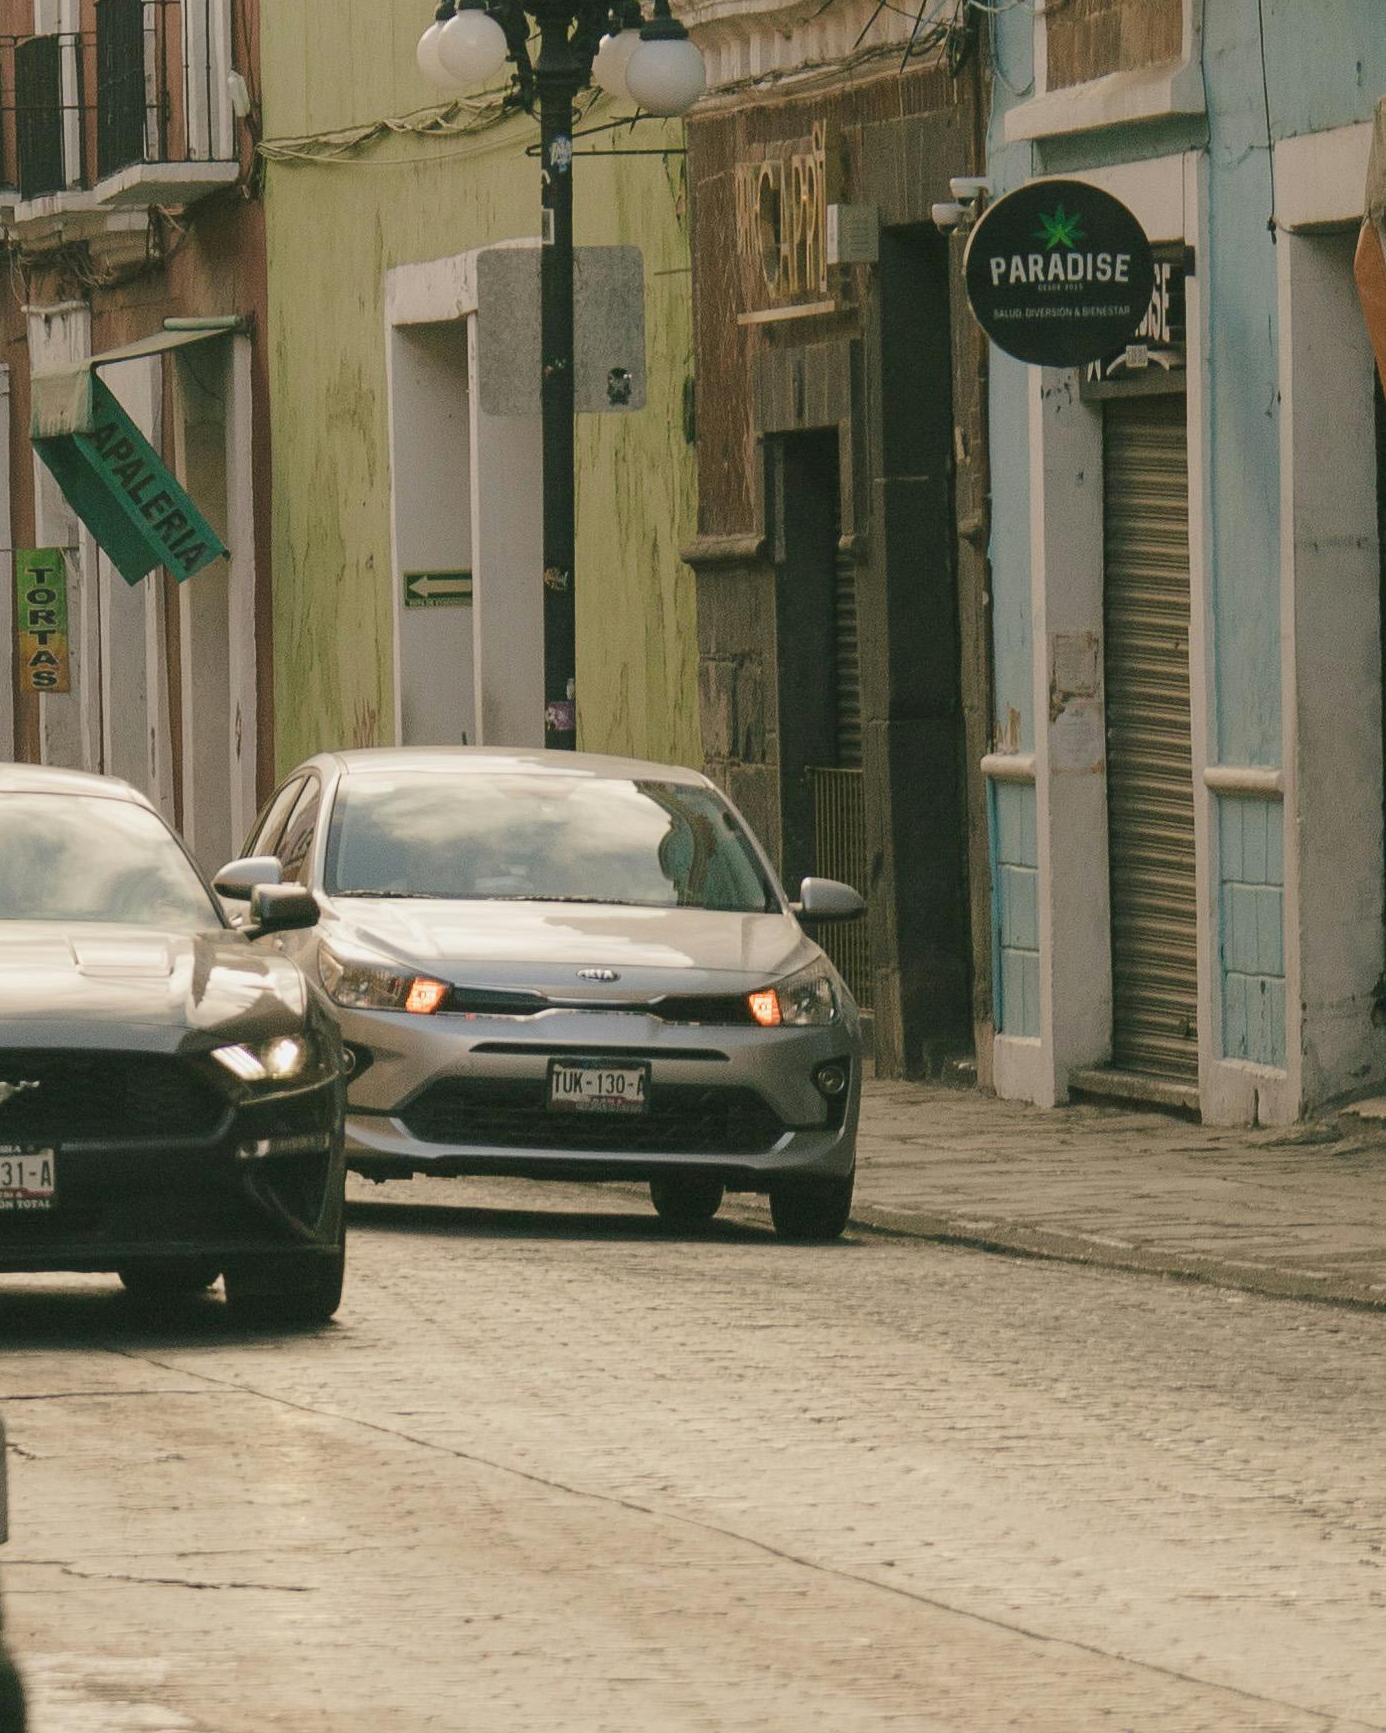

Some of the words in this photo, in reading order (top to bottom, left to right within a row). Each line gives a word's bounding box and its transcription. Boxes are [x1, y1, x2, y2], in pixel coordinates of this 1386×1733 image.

[989, 252, 1131, 286] PARADISE
[25, 567, 60, 689] TORTAS
[553, 1070, 645, 1097] TUK-130-A
[16, 1198, 52, 1209] TOTAL
